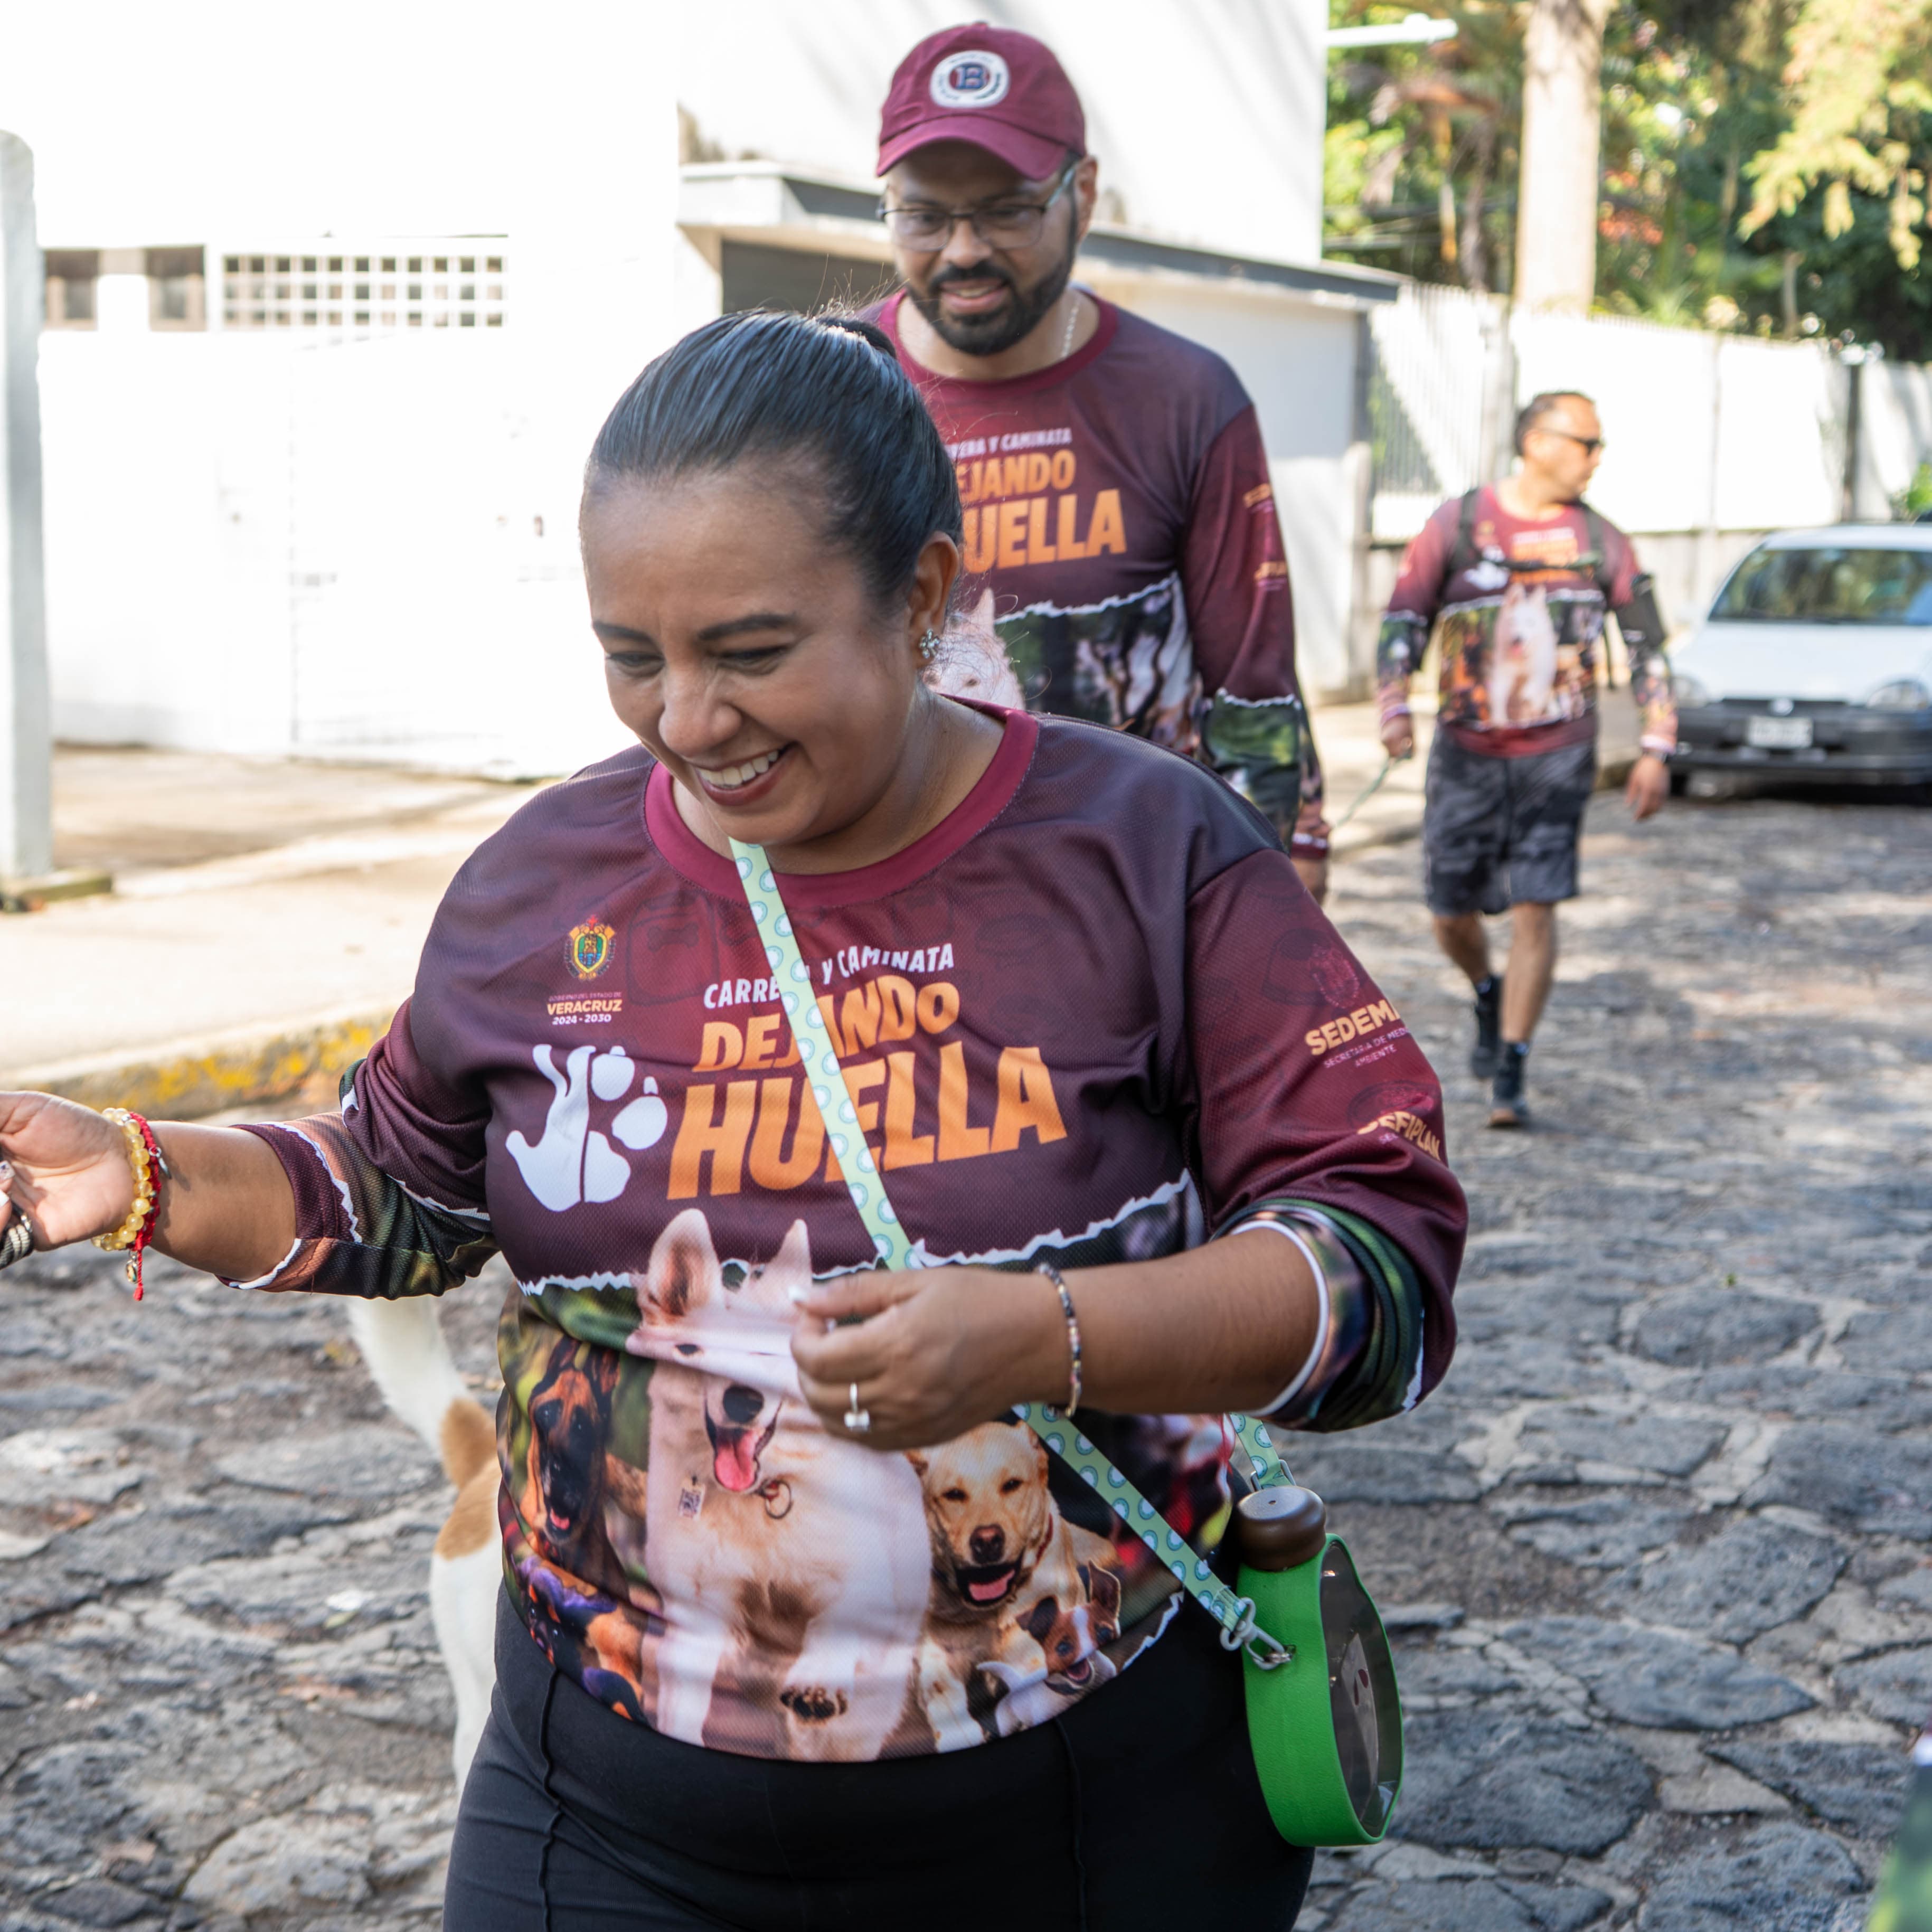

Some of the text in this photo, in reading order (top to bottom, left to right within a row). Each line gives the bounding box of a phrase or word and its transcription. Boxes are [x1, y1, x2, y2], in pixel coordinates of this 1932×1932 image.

[988, 435, 1000, 454] Y
[1001, 427, 1072, 451] CAMINATA
[956, 449, 1076, 503] EJANDO
[963, 488, 1127, 574] UELLA
[822, 958, 833, 985] Y
[837, 943, 955, 978] CAMINATA
[546, 999, 623, 1015] VERACRUZ
[552, 1015, 577, 1025] 2024
[584, 1013, 611, 1023] 2030
[1373, 1035, 1388, 1047] DE
